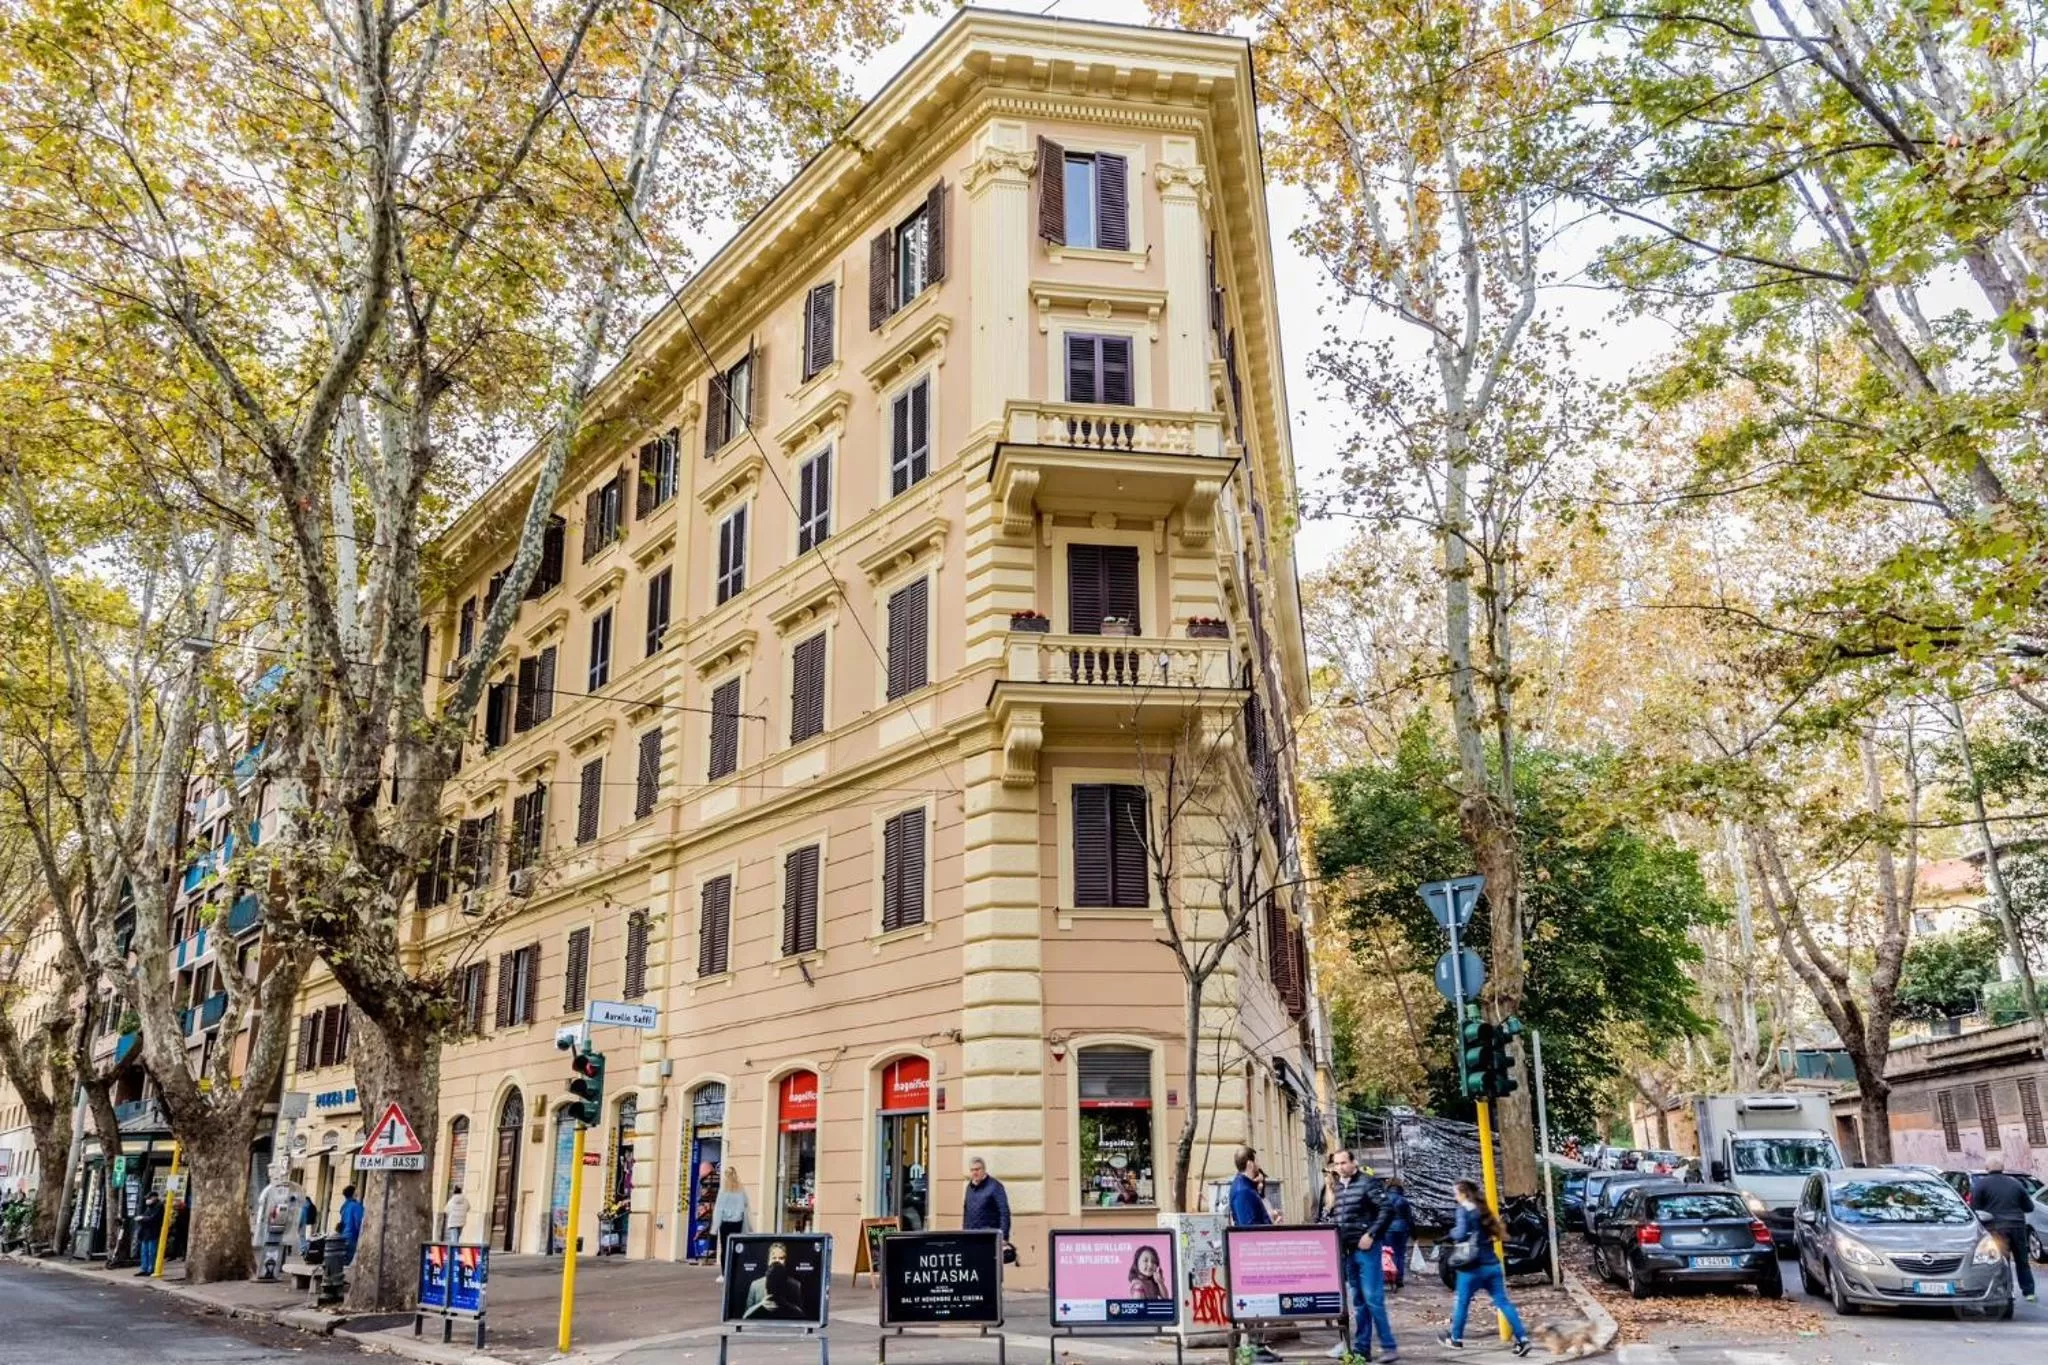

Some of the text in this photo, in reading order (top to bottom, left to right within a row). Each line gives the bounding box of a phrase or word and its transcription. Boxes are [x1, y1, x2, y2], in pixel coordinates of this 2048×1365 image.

[604, 1011, 652, 1025] Aurelio Saffi
[360, 1157, 419, 1168] RAMI BASSI
[919, 1254, 962, 1268] NOTTE
[904, 1269, 979, 1284] FANTASMA
